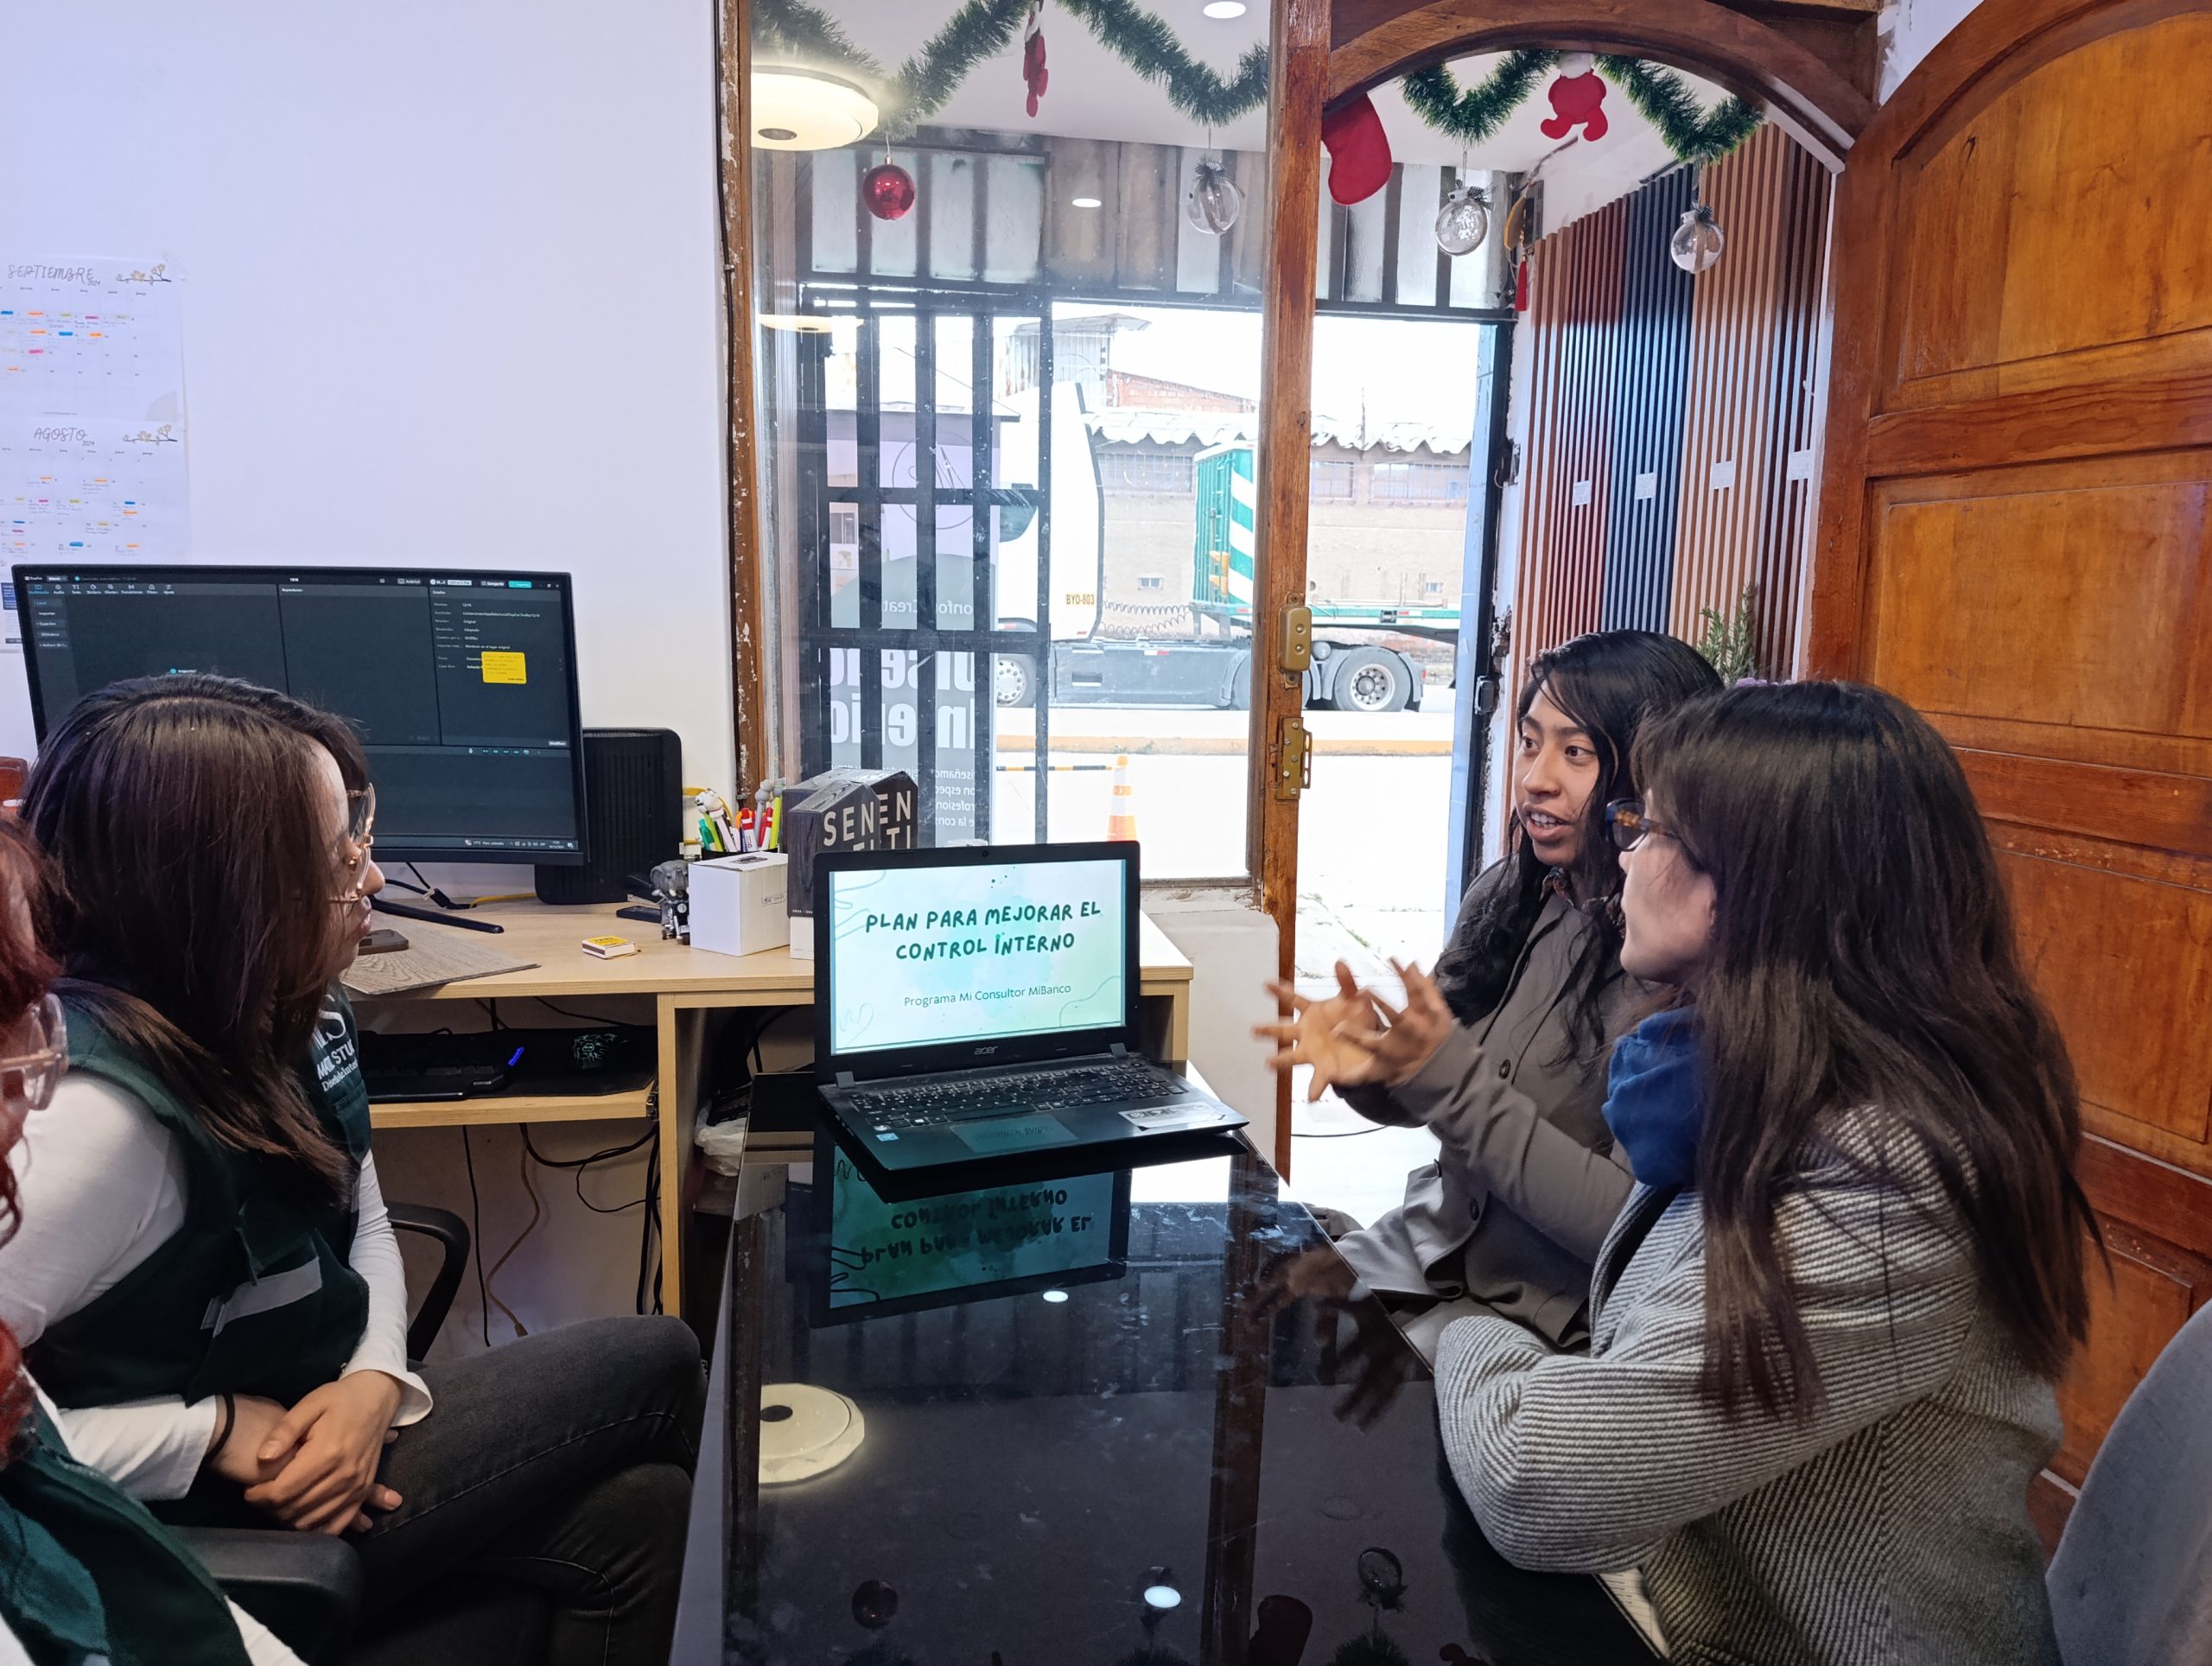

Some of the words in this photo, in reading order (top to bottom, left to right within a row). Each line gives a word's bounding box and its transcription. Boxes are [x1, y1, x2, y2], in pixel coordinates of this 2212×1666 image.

[8, 264, 94, 283] SEPTIEMBRE
[34, 427, 88, 442] AGOSTO
[1065, 594, 1095, 605] BYO-803
[823, 801, 874, 847] SEN
[866, 912, 918, 933] PLAN
[926, 908, 977, 930] PARA
[985, 904, 1073, 925] MEJORAR
[1080, 901, 1102, 918] EL
[896, 938, 987, 961] CONTROL
[904, 994, 957, 1008] Programa
[959, 991, 972, 1002] Mi
[975, 988, 1026, 1001] Consultor
[1028, 985, 1071, 995] MiBanco
[974, 1046, 999, 1055] acer
